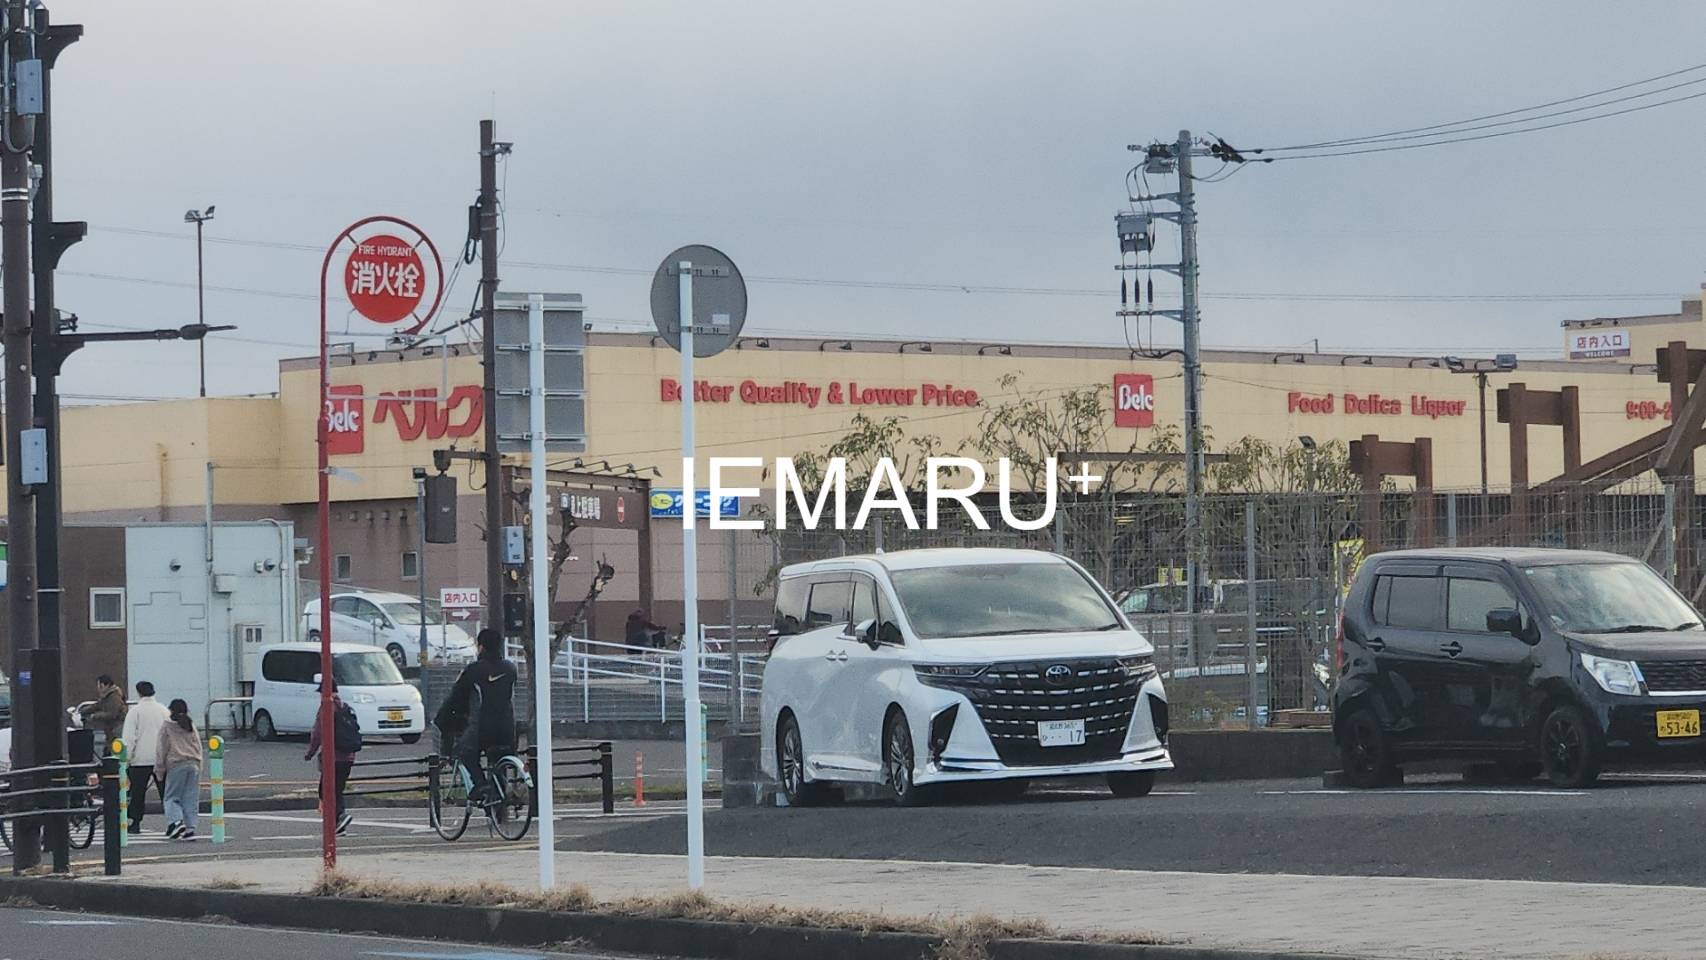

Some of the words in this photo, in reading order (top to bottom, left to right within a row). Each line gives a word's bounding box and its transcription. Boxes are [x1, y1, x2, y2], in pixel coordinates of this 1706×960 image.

[358, 244, 375, 255] FIRE
[377, 245, 413, 257] HYDRANT
[351, 260, 420, 298] 消火栓
[1576, 335, 1622, 349] 店内入口
[739, 380, 822, 409] Quality
[827, 381, 844, 405] &
[849, 382, 918, 406] Lower
[1118, 384, 1154, 411] Belc
[1287, 391, 1334, 414] Food
[1343, 393, 1402, 415] Delica
[1410, 394, 1467, 419] Liquor
[372, 384, 484, 441] ベルク
[444, 592, 478, 603] 店内入口
